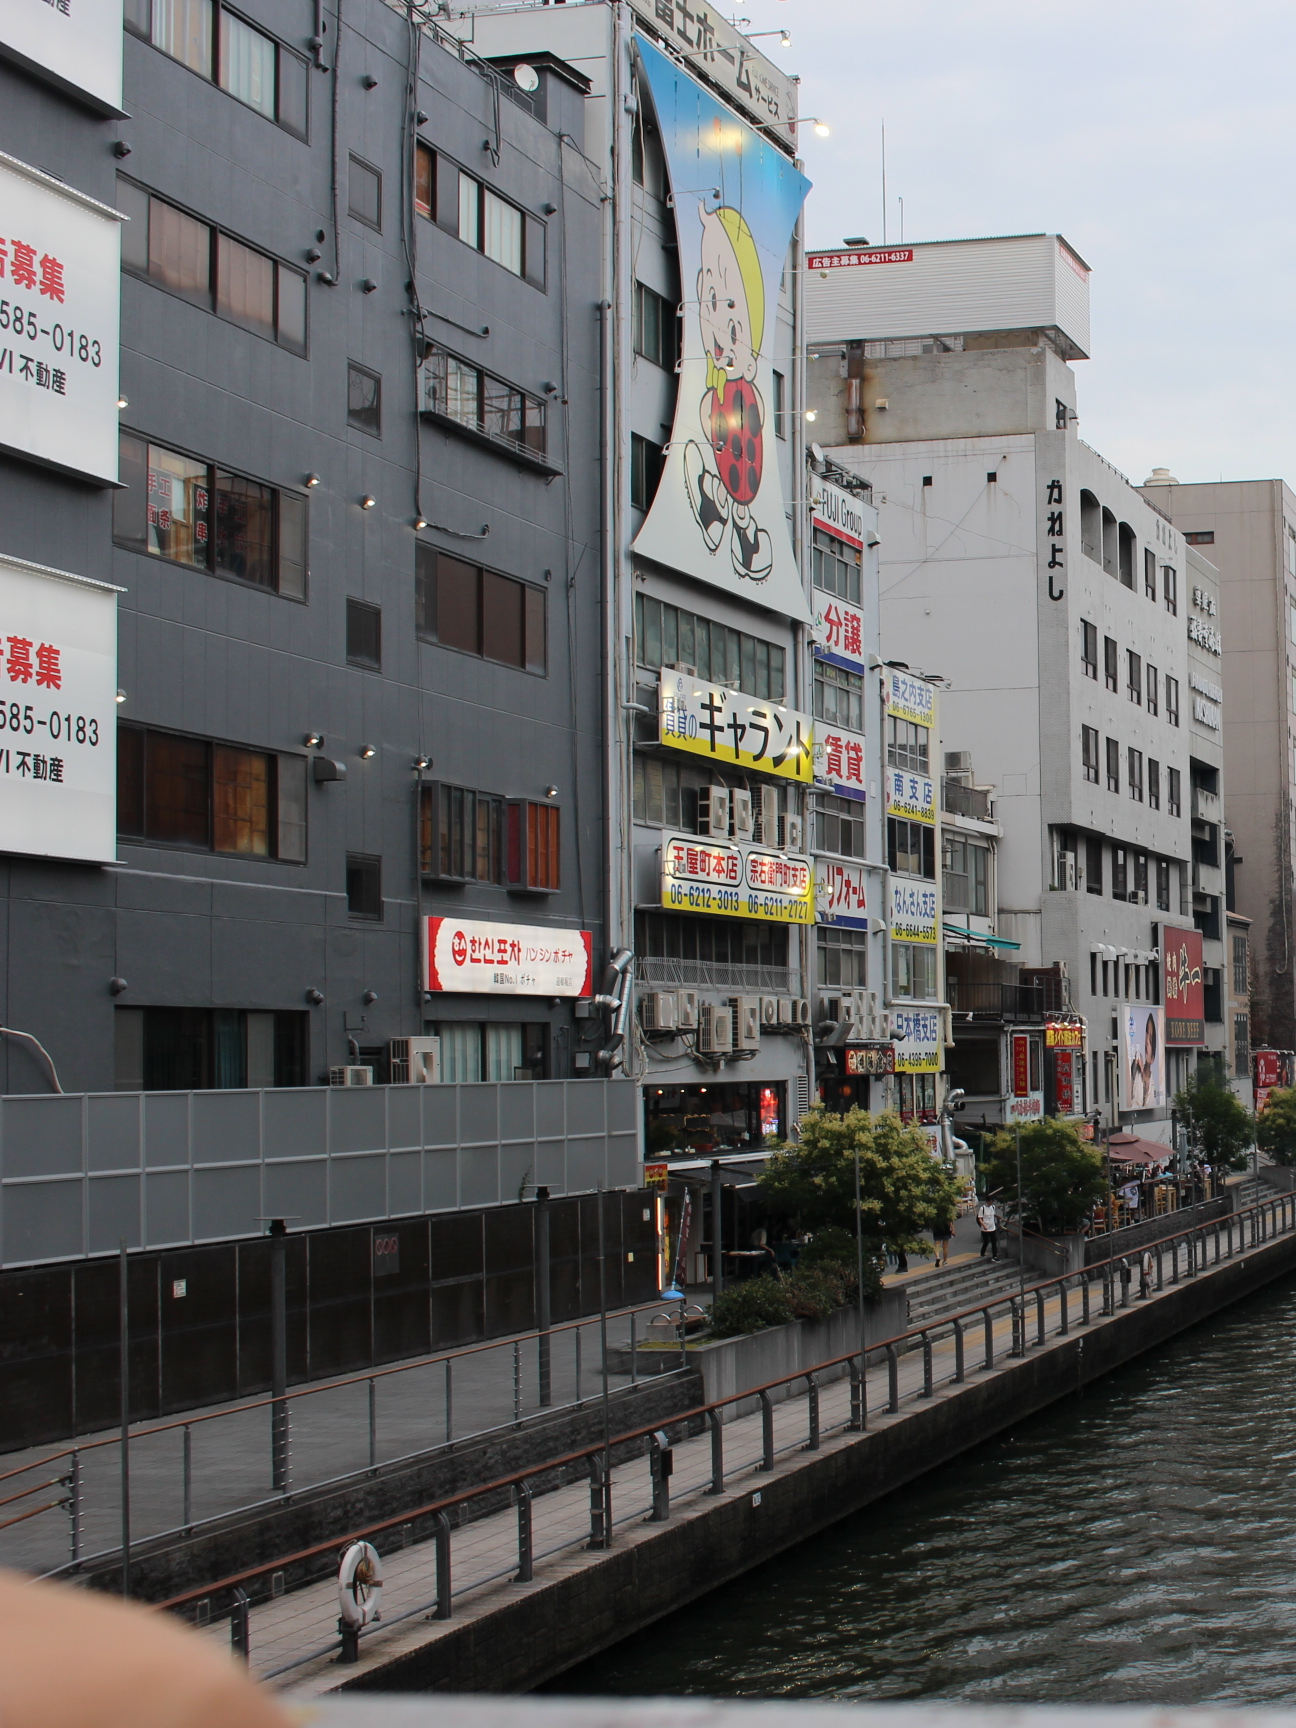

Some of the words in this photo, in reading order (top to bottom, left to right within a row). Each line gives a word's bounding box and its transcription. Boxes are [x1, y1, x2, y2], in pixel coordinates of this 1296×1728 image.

[754, 84, 780, 120] サービス
[812, 255, 859, 268] 広告主募集
[860, 251, 909, 263] 06-6211-6337
[19, 354, 66, 396] 不動産
[822, 487, 841, 524] FUJI
[841, 500, 863, 540] Group
[1046, 479, 1064, 601] かねよし
[823, 602, 864, 658] 分譲
[0, 635, 62, 690] 募集
[892, 675, 933, 711] 島之内支店
[892, 701, 933, 725] 06-6765-1306
[700, 692, 811, 776] ギャラント
[16, 751, 64, 783] 不動産
[823, 733, 864, 785] 賃貸
[893, 772, 933, 805] 南支店
[893, 799, 935, 821] 06-6241-8839
[749, 859, 807, 890] 宗右衛門町支店
[827, 864, 866, 910] リフォーム
[670, 883, 739, 912] 06-6212-3013
[748, 894, 808, 920] 06-6211-2727
[894, 886, 936, 919] なんさん支店
[895, 922, 937, 940] 06-6644-5573
[469, 936, 521, 965] 한신포차
[896, 1013, 938, 1043] 日本橋支店
[1170, 1022, 1185, 1038] KOBE
[1187, 1022, 1199, 1038] BEEF
